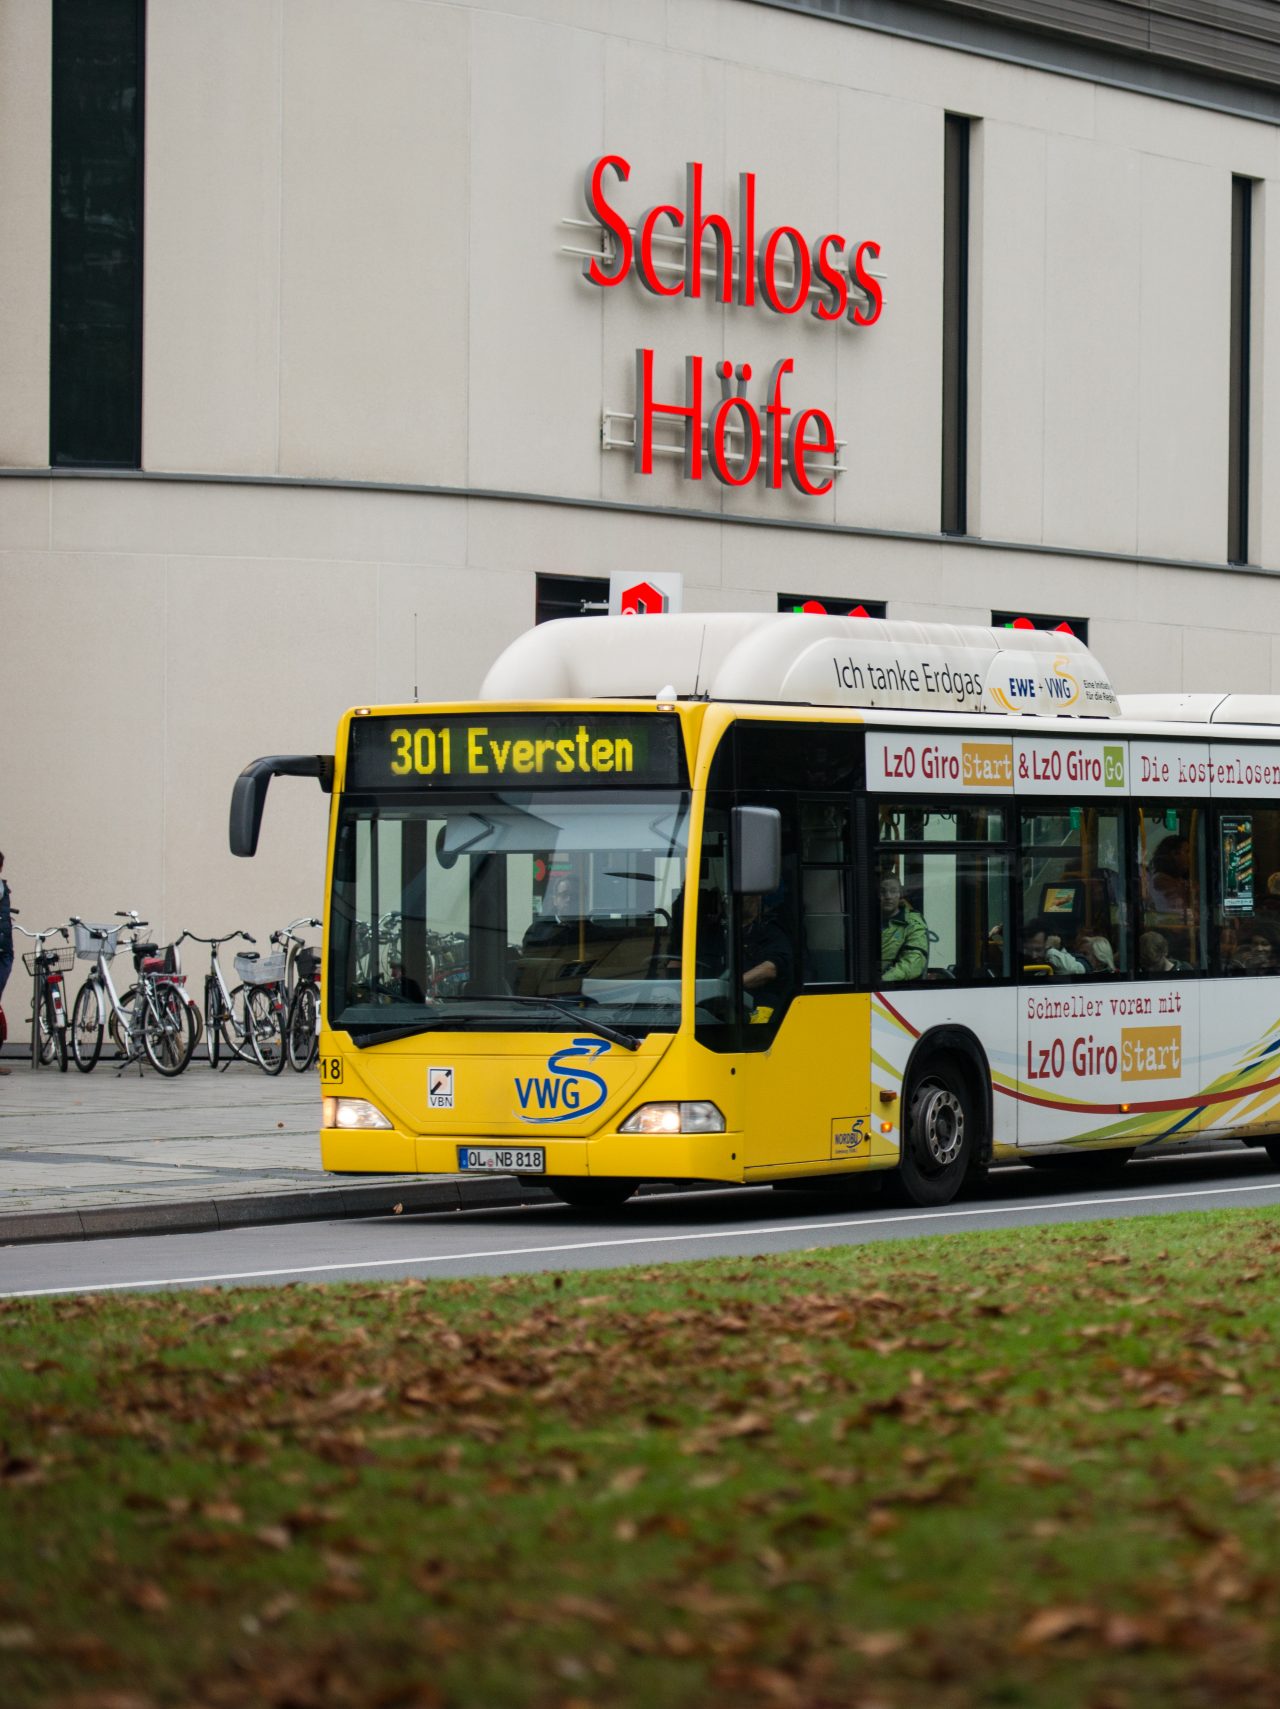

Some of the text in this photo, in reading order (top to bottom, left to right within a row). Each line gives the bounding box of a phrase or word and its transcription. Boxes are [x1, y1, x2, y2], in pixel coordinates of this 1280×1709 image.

[582, 154, 883, 326] Schloss
[634, 348, 836, 496] Höfe
[833, 657, 983, 703] Ich tanke Erdgas
[1009, 677, 1036, 698] EWE
[1045, 677, 1071, 699] VWG
[390, 725, 633, 775] 301 Eversten
[884, 746, 1123, 782] LzO Giro Start & LzO Giro Go
[1141, 755, 1169, 783] Die
[1178, 757, 1280, 785] kostenlosen
[1027, 991, 1182, 1019] Schneller voran mit
[1027, 1034, 1180, 1079] LzO Giro Start
[430, 1096, 453, 1107] VBN
[514, 1077, 580, 1109] VWG
[468, 1151, 541, 1168] OL NB 818
